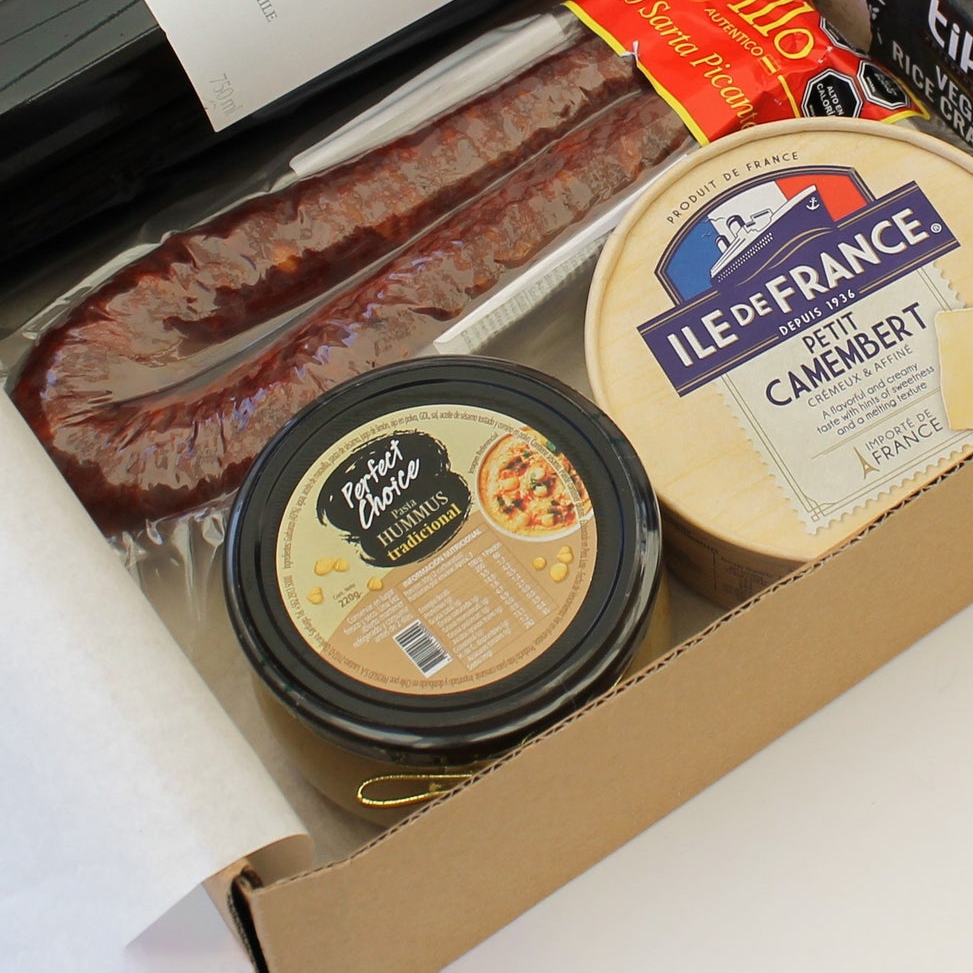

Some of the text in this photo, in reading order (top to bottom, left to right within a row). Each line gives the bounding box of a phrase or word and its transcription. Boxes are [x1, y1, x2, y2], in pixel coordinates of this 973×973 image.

[639, 0, 698, 57] Sarta
[704, 8, 764, 57] AUTENTICO
[827, 85, 839, 105] ALTO
[892, 41, 935, 103] RICE
[666, 151, 799, 224] PRODUIT DE FRANCE
[667, 207, 930, 367] ILE DE FRANCE
[778, 289, 856, 336] DEPUIS 1936
[765, 302, 927, 406] CAMEMBERT
[802, 312, 859, 354] PETIT
[816, 366, 935, 435] taste with hints of sweetness
[822, 363, 918, 420] A flavorful and creamy
[862, 368, 872, 378] &
[837, 382, 928, 435] and a melting texture
[916, 408, 932, 423] DE
[872, 417, 943, 464] FRANCE
[341, 439, 403, 508] Perfect
[359, 458, 420, 530] Choice
[376, 490, 449, 547] HUMMUS
[386, 503, 462, 561] tradicional
[390, 499, 418, 519] Pasta
